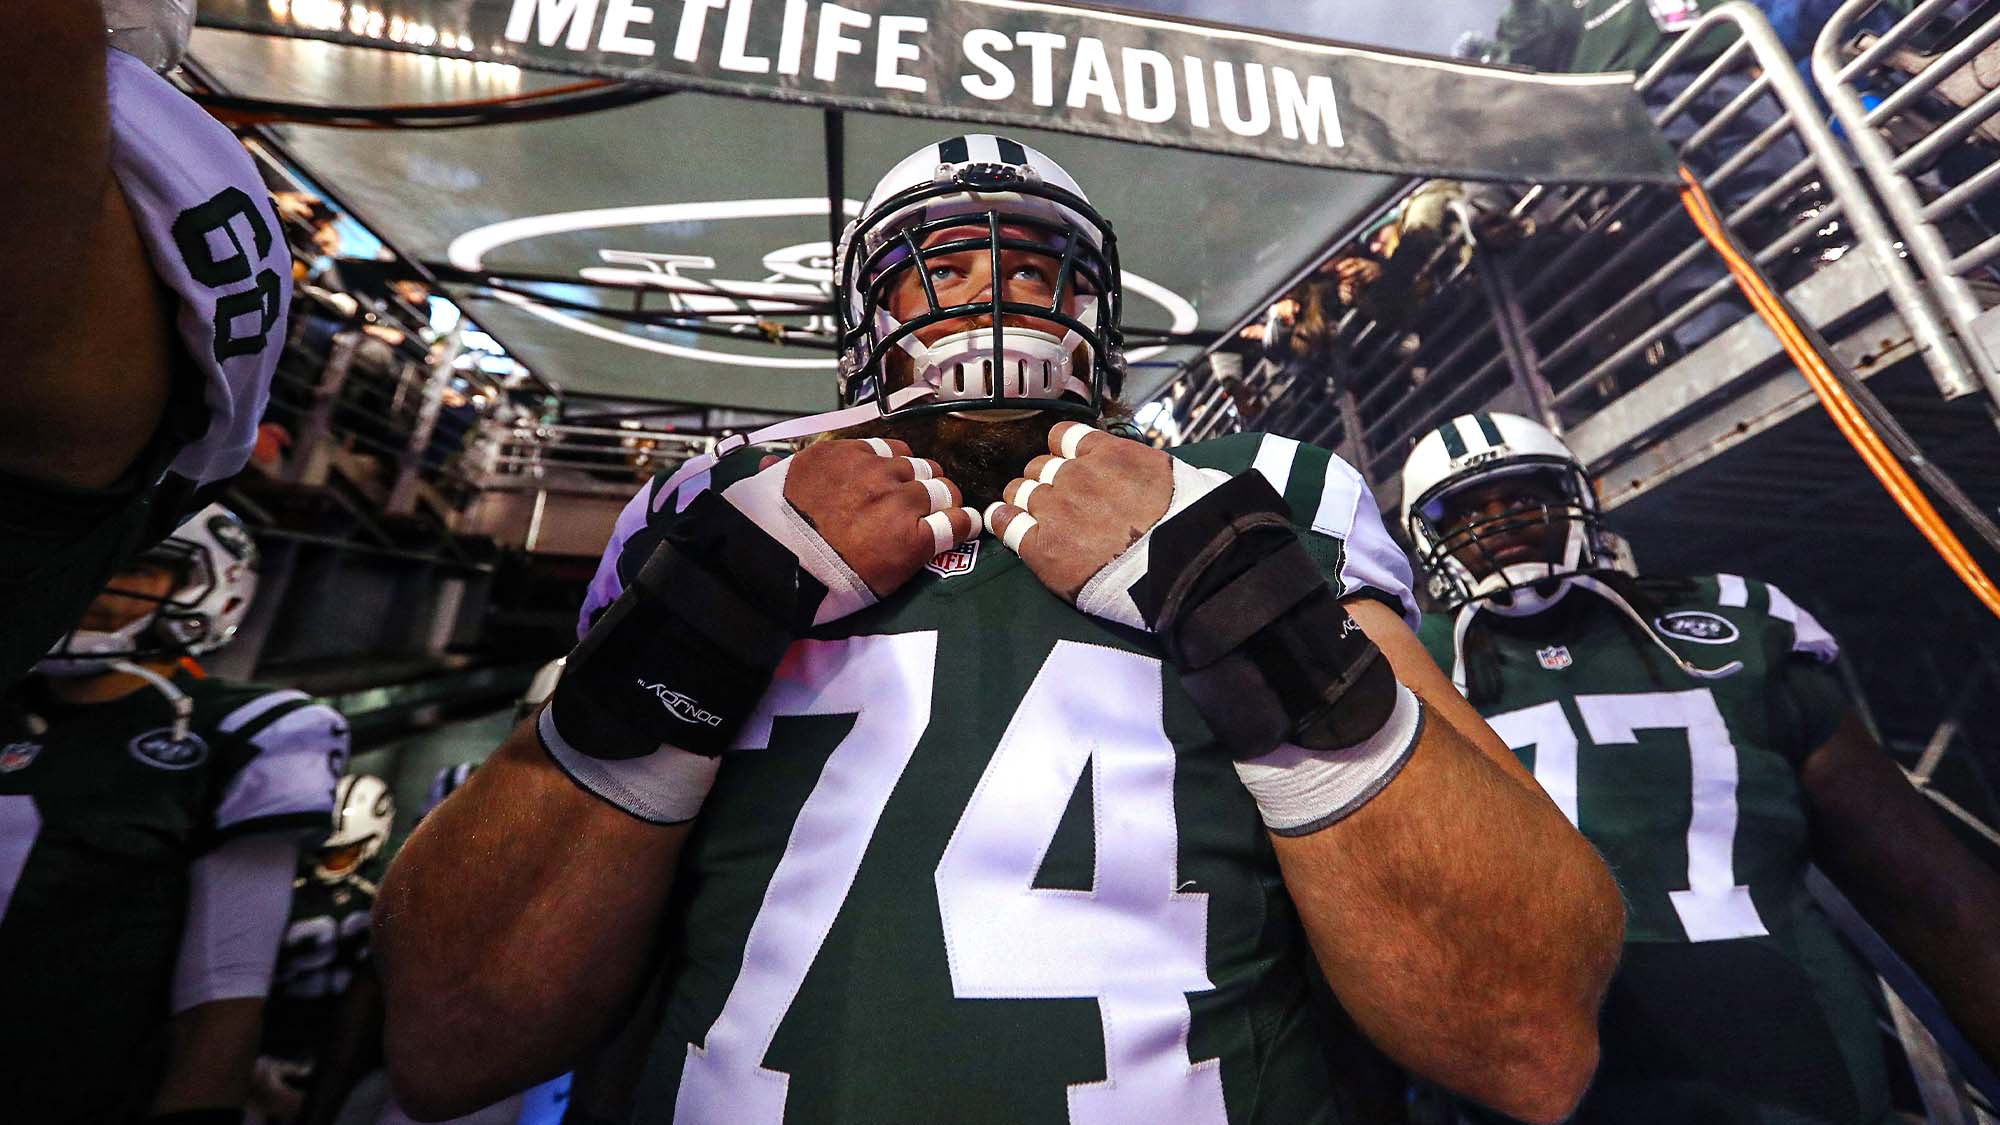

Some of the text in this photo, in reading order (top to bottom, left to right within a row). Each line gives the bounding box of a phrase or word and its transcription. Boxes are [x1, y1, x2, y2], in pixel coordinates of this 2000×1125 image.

[505, 0, 1345, 149] METLIFE STADIUM
[931, 554, 967, 570] NFL
[673, 630, 1229, 1125] 74
